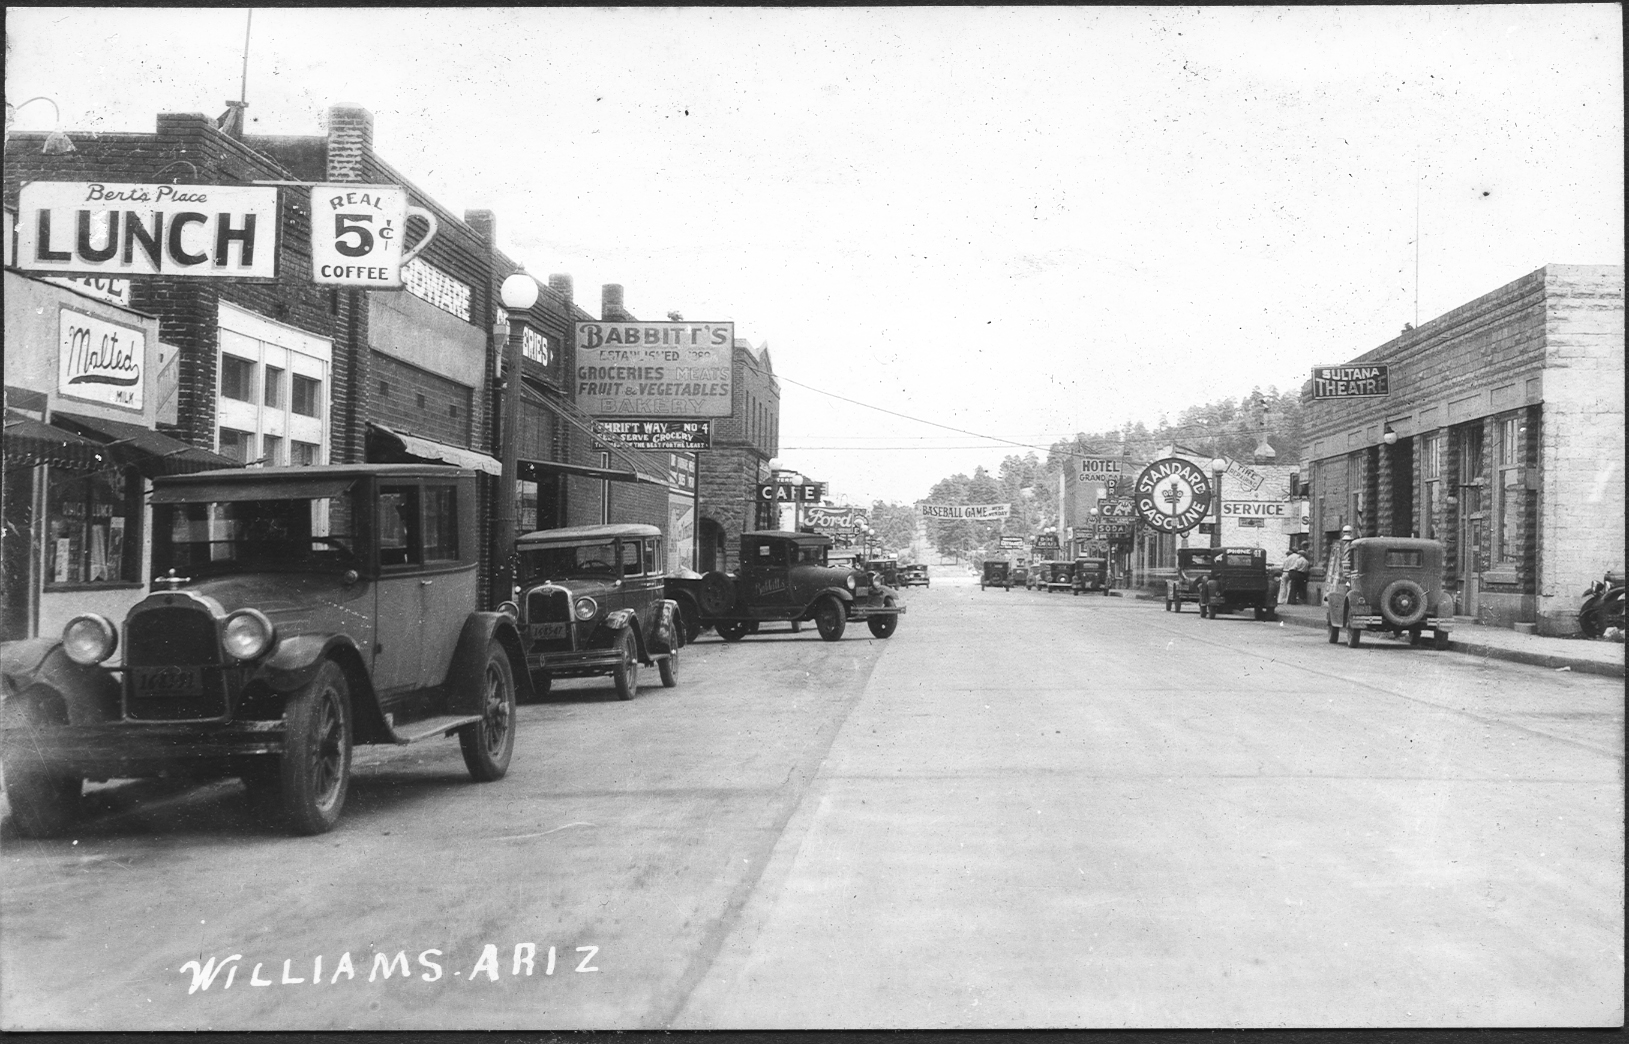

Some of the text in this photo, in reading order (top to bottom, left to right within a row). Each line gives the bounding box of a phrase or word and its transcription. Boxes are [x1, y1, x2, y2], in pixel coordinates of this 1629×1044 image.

[85, 184, 207, 203] Bert's Place
[330, 193, 383, 210] REAL
[35, 208, 257, 272] LUNCH
[321, 265, 389, 281] COFFEE
[579, 324, 728, 349] BABBITT'S
[67, 325, 140, 379] Malted
[578, 367, 730, 380] GROCERIES MEATS
[1322, 367, 1380, 380] SULTANA
[578, 382, 623, 396] FRUIT
[638, 383, 729, 396] VEGETABLES
[1316, 376, 1387, 396] THEATRE
[115, 391, 134, 404] MILK
[600, 399, 706, 414] BAKERY
[643, 422, 668, 433] WAY
[683, 423, 697, 431] NO
[701, 423, 708, 434] 4
[652, 431, 694, 443] GROCERY
[1082, 460, 1120, 472] HOTEL
[1238, 465, 1256, 480] TIRE
[1079, 474, 1106, 482] GRAND
[1140, 463, 1205, 495] STANDARD
[762, 486, 815, 499] CAFE
[922, 505, 963, 518] BASEBALL
[965, 507, 988, 518] GAME
[1140, 499, 1205, 530] GASOLINE
[1223, 503, 1285, 515] SERVICE
[804, 507, 852, 528] Ford
